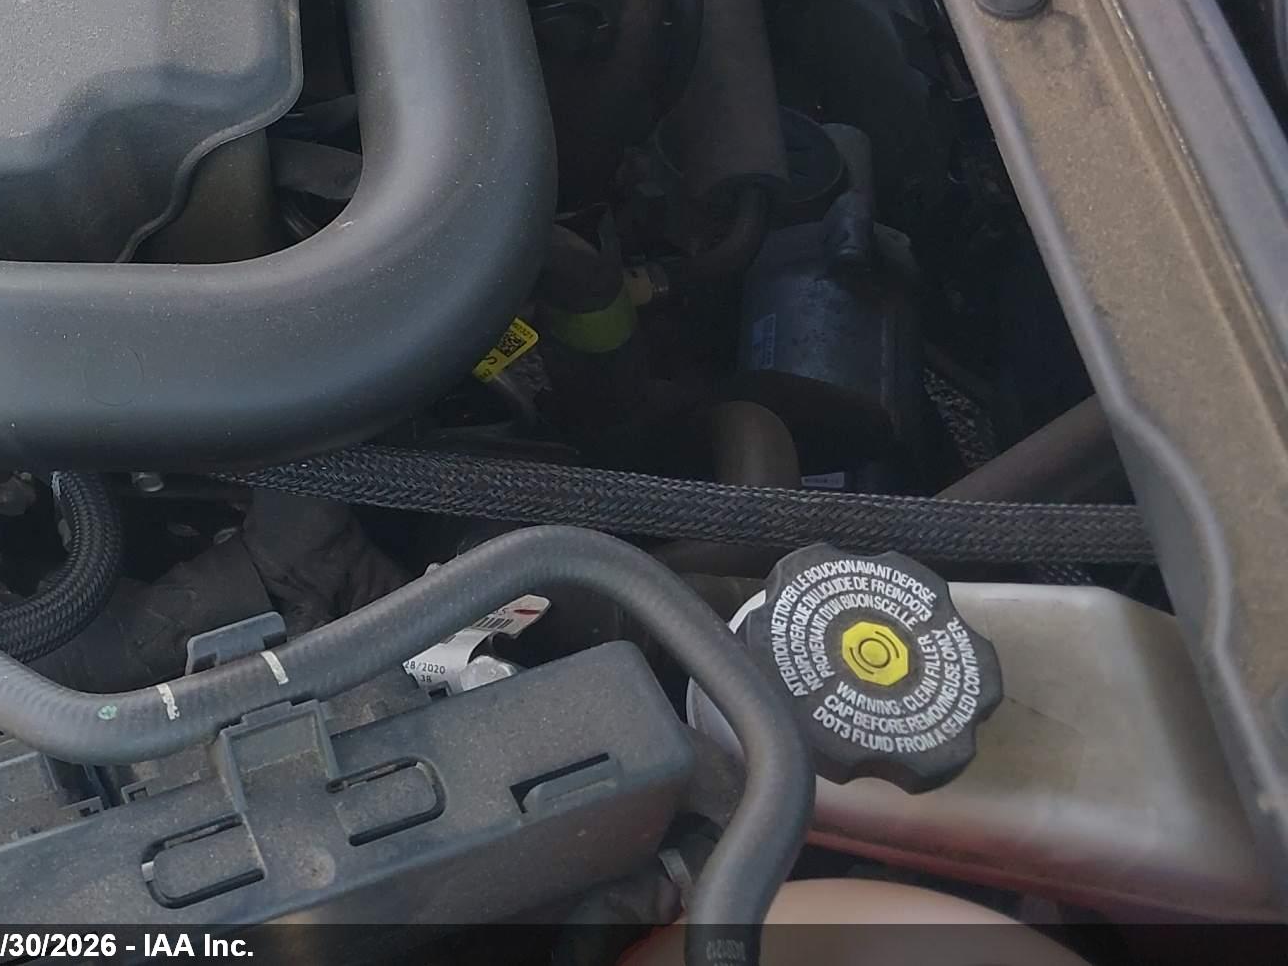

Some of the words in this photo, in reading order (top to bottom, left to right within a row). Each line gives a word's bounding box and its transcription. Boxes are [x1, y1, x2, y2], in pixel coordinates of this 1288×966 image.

[771, 585, 801, 634] NETTOYER
[792, 574, 810, 591] LE
[804, 560, 856, 584] BOUCHON
[856, 560, 892, 580] AVANT
[792, 602, 812, 626] QUE
[802, 589, 821, 610] DU
[817, 576, 854, 600] LIQUIDE
[853, 576, 869, 591] DE
[871, 578, 904, 602] FREIN
[902, 593, 932, 622] DOT3
[808, 614, 835, 679] PROVENANT
[839, 593, 873, 610] BIDON
[931, 629, 958, 662] ONLY
[917, 634, 941, 679] FILLER
[943, 662, 961, 688] USE
[824, 694, 854, 717] CAP
[836, 681, 905, 716] WARNING:
[902, 676, 938, 712] CLEAN
[813, 706, 851, 739] DOT3
[852, 728, 894, 752] FLUID
[895, 732, 938, 753] FROM
[933, 728, 948, 744] A
[941, 694, 978, 737] SEALED
[853, 710, 909, 734] BEFORE
